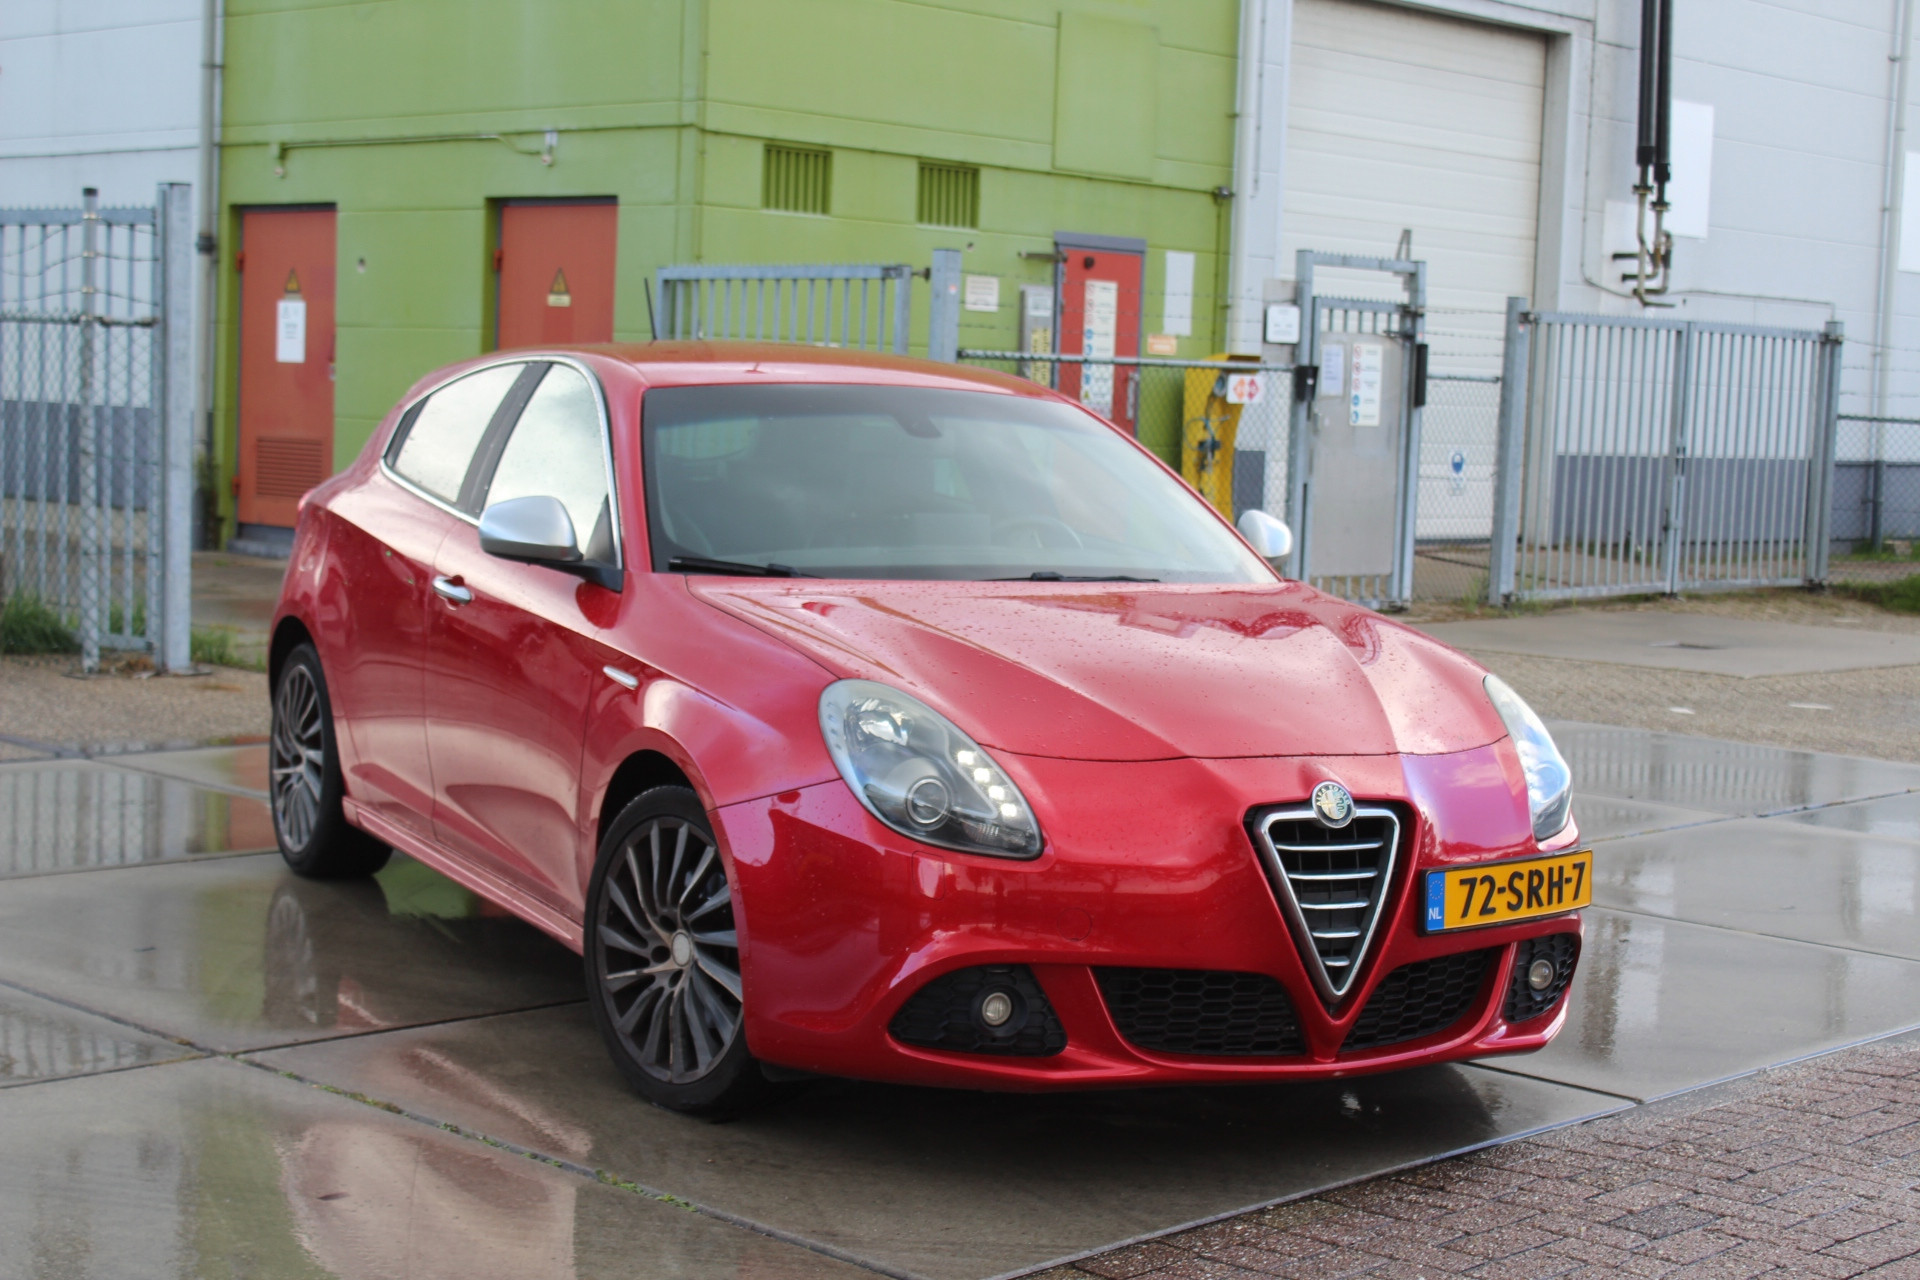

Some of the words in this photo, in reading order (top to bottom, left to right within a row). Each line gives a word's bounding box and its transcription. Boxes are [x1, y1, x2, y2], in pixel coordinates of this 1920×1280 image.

[1316, 788, 1327, 806] ALFA
[1328, 785, 1351, 805] ROMEO
[1459, 861, 1586, 919] 72-SRH-7
[1428, 907, 1442, 921] NL
